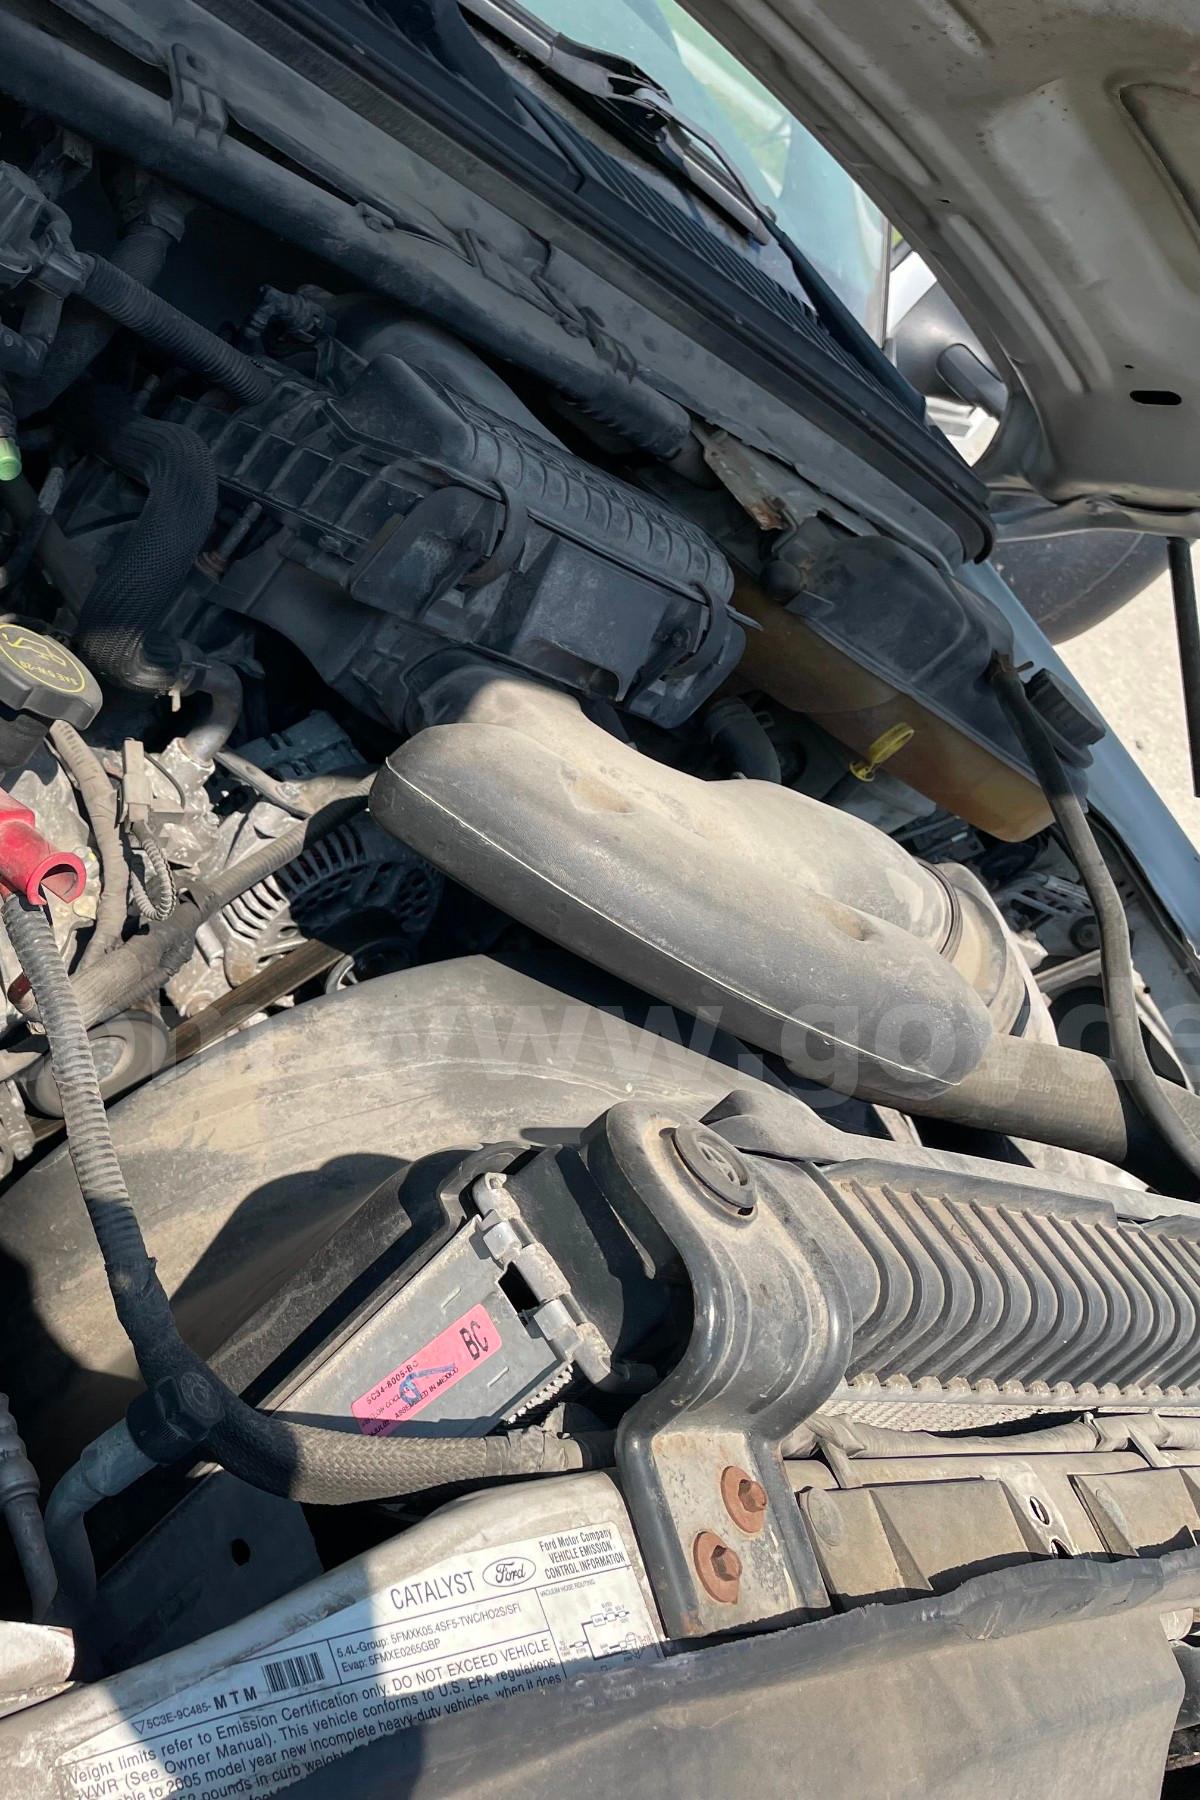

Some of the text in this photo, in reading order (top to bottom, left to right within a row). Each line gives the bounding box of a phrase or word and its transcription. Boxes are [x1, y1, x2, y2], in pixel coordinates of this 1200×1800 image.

[459, 1320, 489, 1360] BC
[366, 1360, 419, 1404] 5C34-8005-BC
[538, 1524, 613, 1552] Ford Motor Company
[548, 1538, 613, 1565] VEHICLE EMISSION
[491, 1557, 527, 1585] Ford
[543, 1550, 626, 1580] CONTROL INFORMATION
[389, 1568, 477, 1611] CATALYST
[335, 1634, 390, 1660] 5.4L-Group:
[340, 1637, 443, 1675] Evap: 5FMXE0265GBP
[116, 1747, 158, 1771] limits
[159, 1735, 195, 1757] refer
[196, 1729, 213, 1746] to
[215, 1710, 278, 1740] Emission
[279, 1688, 359, 1722] Certification
[360, 1679, 391, 1703] only.
[391, 1673, 413, 1692] DO
[414, 1665, 445, 1685] NOT
[445, 1650, 499, 1677] EXCEED
[499, 1636, 551, 1663] VEHICLE
[122, 1653, 557, 1790] (See Owner Manual). This vehicle conforms to U.S. EPA regulations
[144, 1685, 258, 1730] 5C3E-9C485- M T M
[147, 1784, 164, 1800] to
[164, 1771, 202, 1794] 2005
[203, 1758, 247, 1782] model
[247, 1751, 280, 1773] year
[279, 1743, 308, 1760] new
[308, 1721, 377, 1754] incomplete
[375, 1702, 443, 1733] heavy-duty
